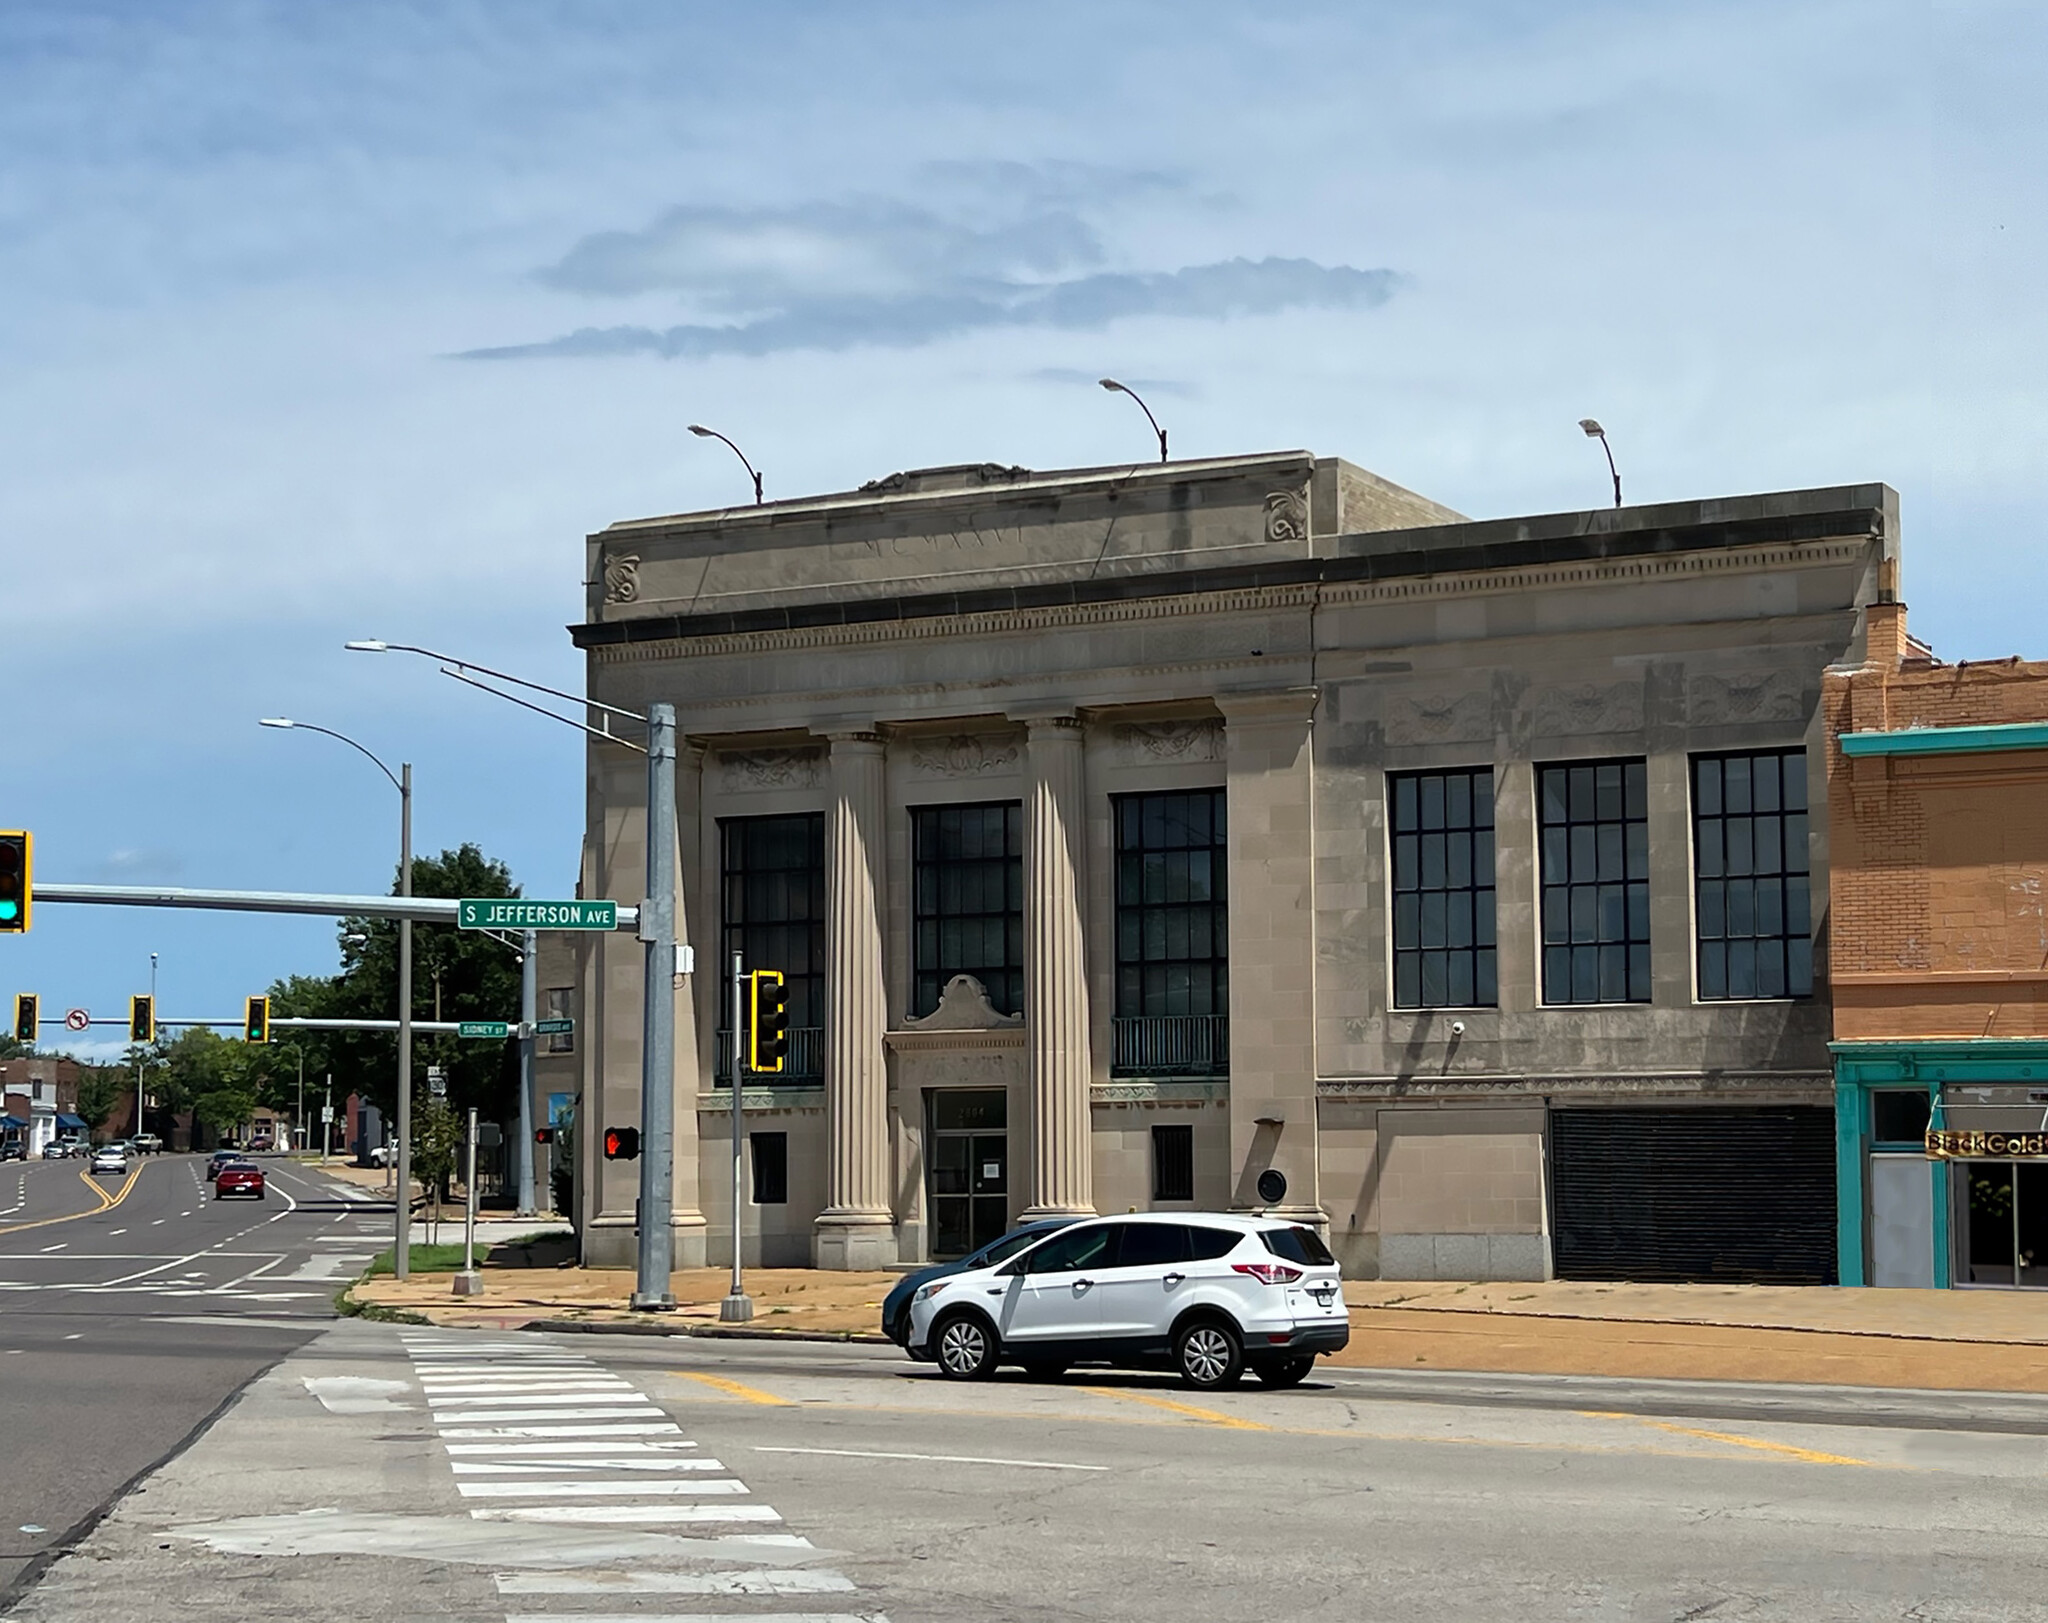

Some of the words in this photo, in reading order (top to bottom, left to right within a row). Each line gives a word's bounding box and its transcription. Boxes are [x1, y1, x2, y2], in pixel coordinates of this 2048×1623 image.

[466, 905, 476, 922] S
[486, 906, 581, 923] JEFFERSON
[587, 910, 610, 924] AVE
[463, 1025, 493, 1035] SIDNEY
